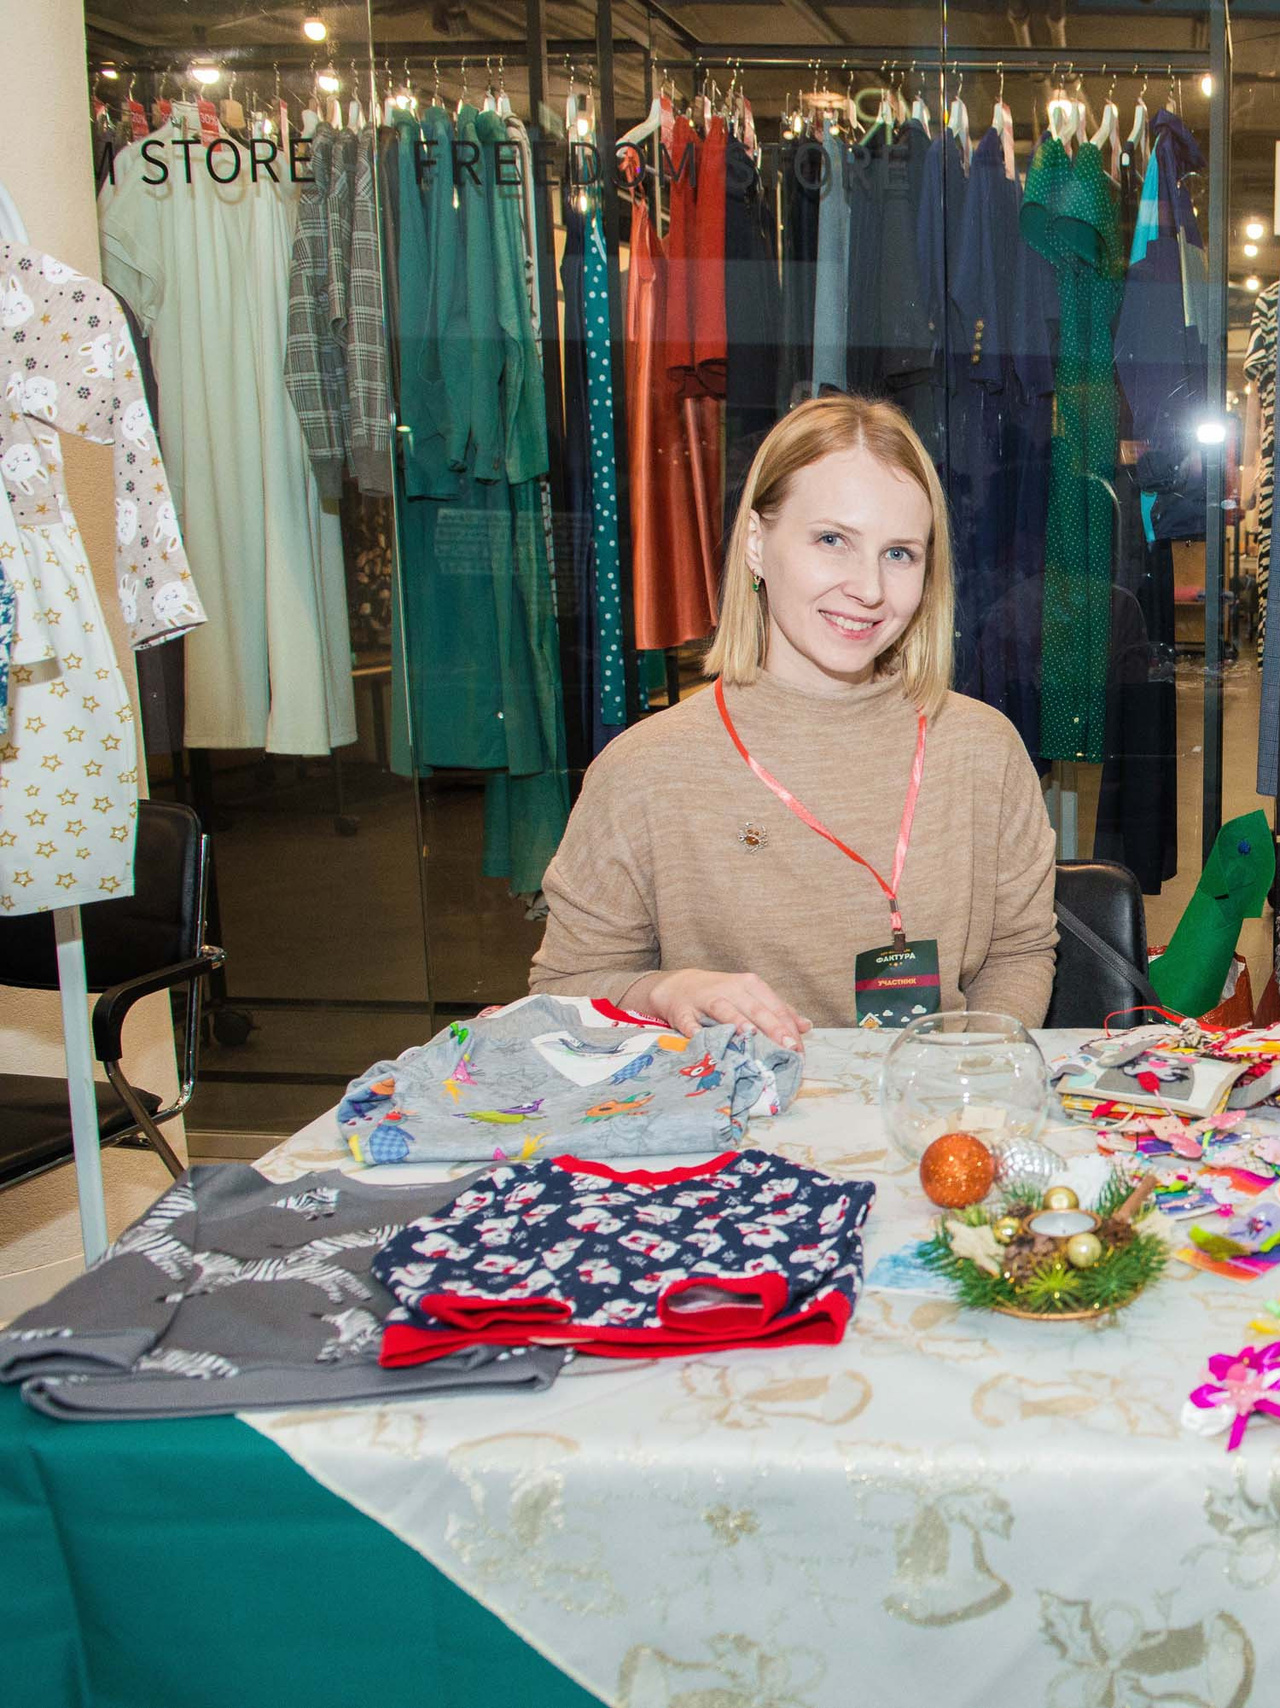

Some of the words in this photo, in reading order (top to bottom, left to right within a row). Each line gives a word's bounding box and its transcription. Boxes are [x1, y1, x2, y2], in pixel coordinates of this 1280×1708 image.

[141, 138, 315, 185] STORE
[414, 140, 697, 188] FREEDOM
[726, 142, 910, 190] STORE
[876, 952, 916, 963] ФАКТУРА
[877, 978, 917, 987] УЧАСТНИК
